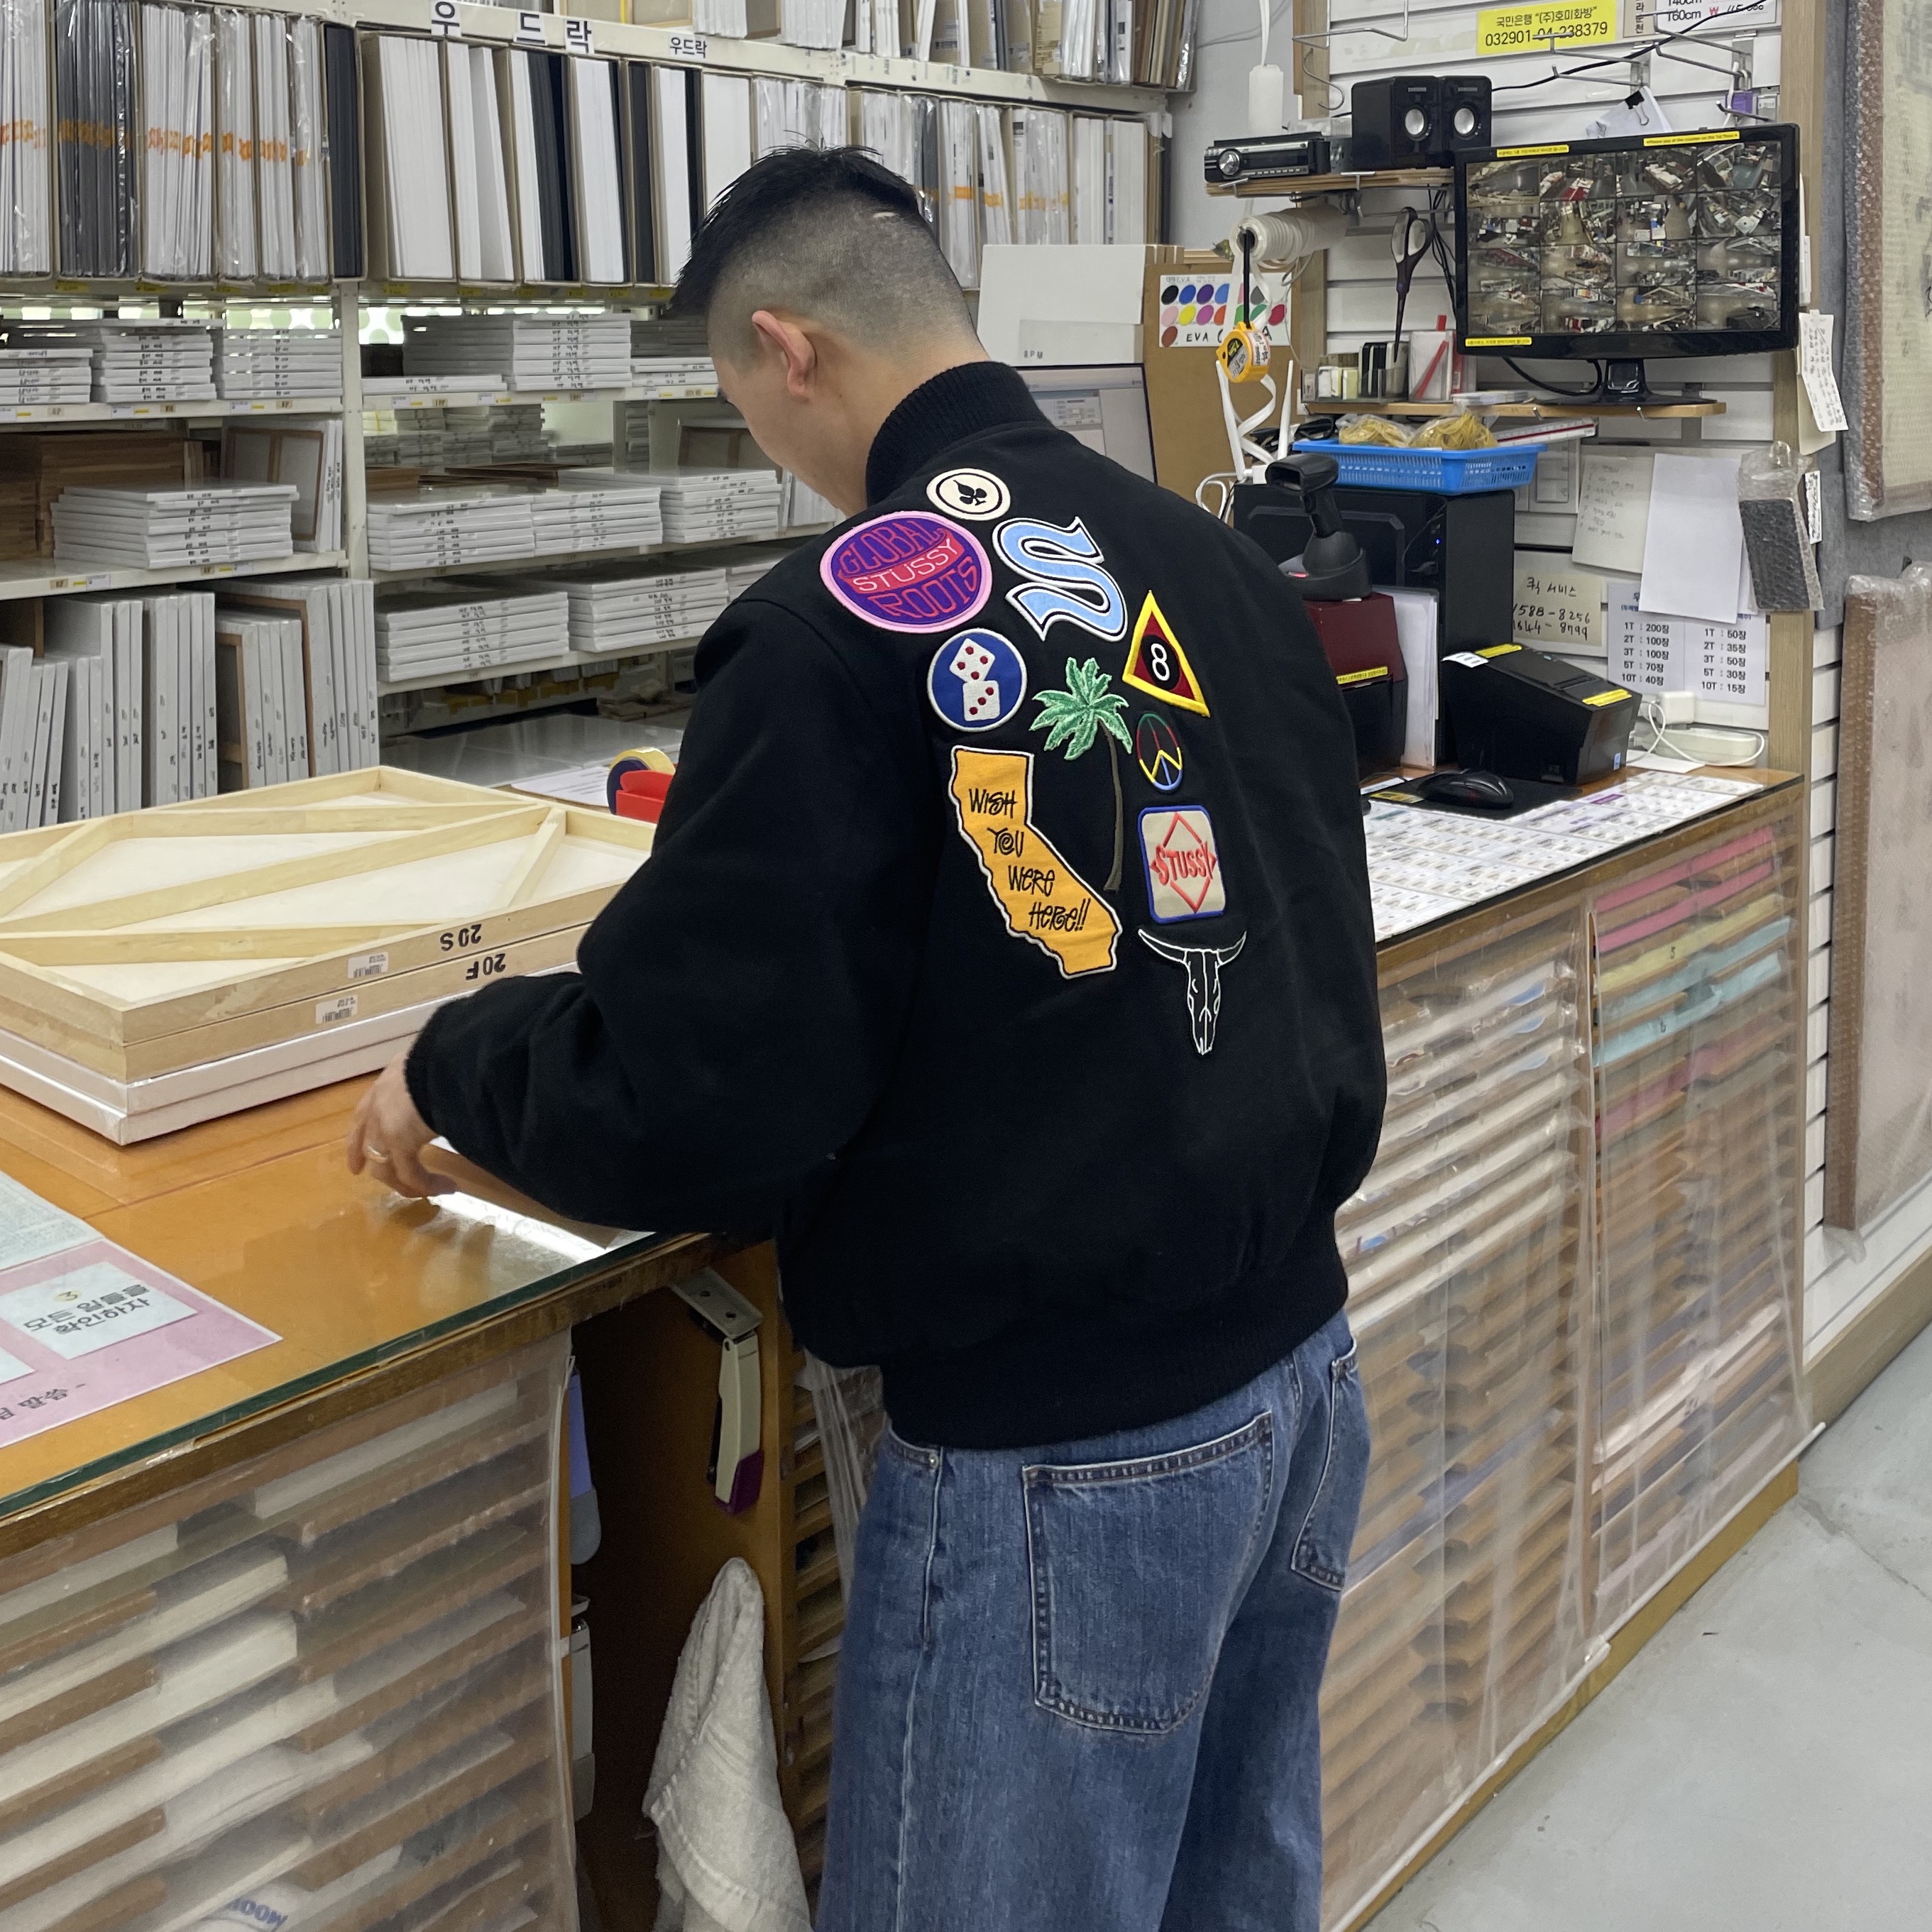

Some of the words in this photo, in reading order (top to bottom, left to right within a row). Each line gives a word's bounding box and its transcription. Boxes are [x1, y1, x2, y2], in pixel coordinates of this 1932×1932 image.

[1496, 13, 1532, 28] 국민은행
[432, 1, 459, 34] 우
[516, 13, 545, 44] 드
[567, 21, 592, 54] 락
[669, 37, 706, 58] 우드락
[1186, 332, 1209, 343] EVA
[838, 520, 944, 574] GLOBAL
[867, 556, 978, 618] ROOTS
[1547, 582, 1576, 597] 서비스
[1646, 624, 1669, 634] 200장
[1728, 630, 1746, 640] 50장
[1647, 637, 1669, 647] 100장
[1727, 644, 1746, 654] 35장
[1151, 642, 1170, 681] 8
[1647, 651, 1669, 660] 100장
[1727, 657, 1745, 667] 50장
[1646, 664, 1663, 673] 70장
[1622, 674, 1636, 683] 10T
[1646, 676, 1664, 686] 40장
[1727, 671, 1745, 680] 30장
[1728, 684, 1745, 693] 15장
[439, 923, 482, 952] 20S
[466, 953, 506, 981] 20F
[59, 1291, 78, 1302] 3
[23, 1309, 77, 1332] 모든
[53, 1297, 151, 1335] 확인하자
